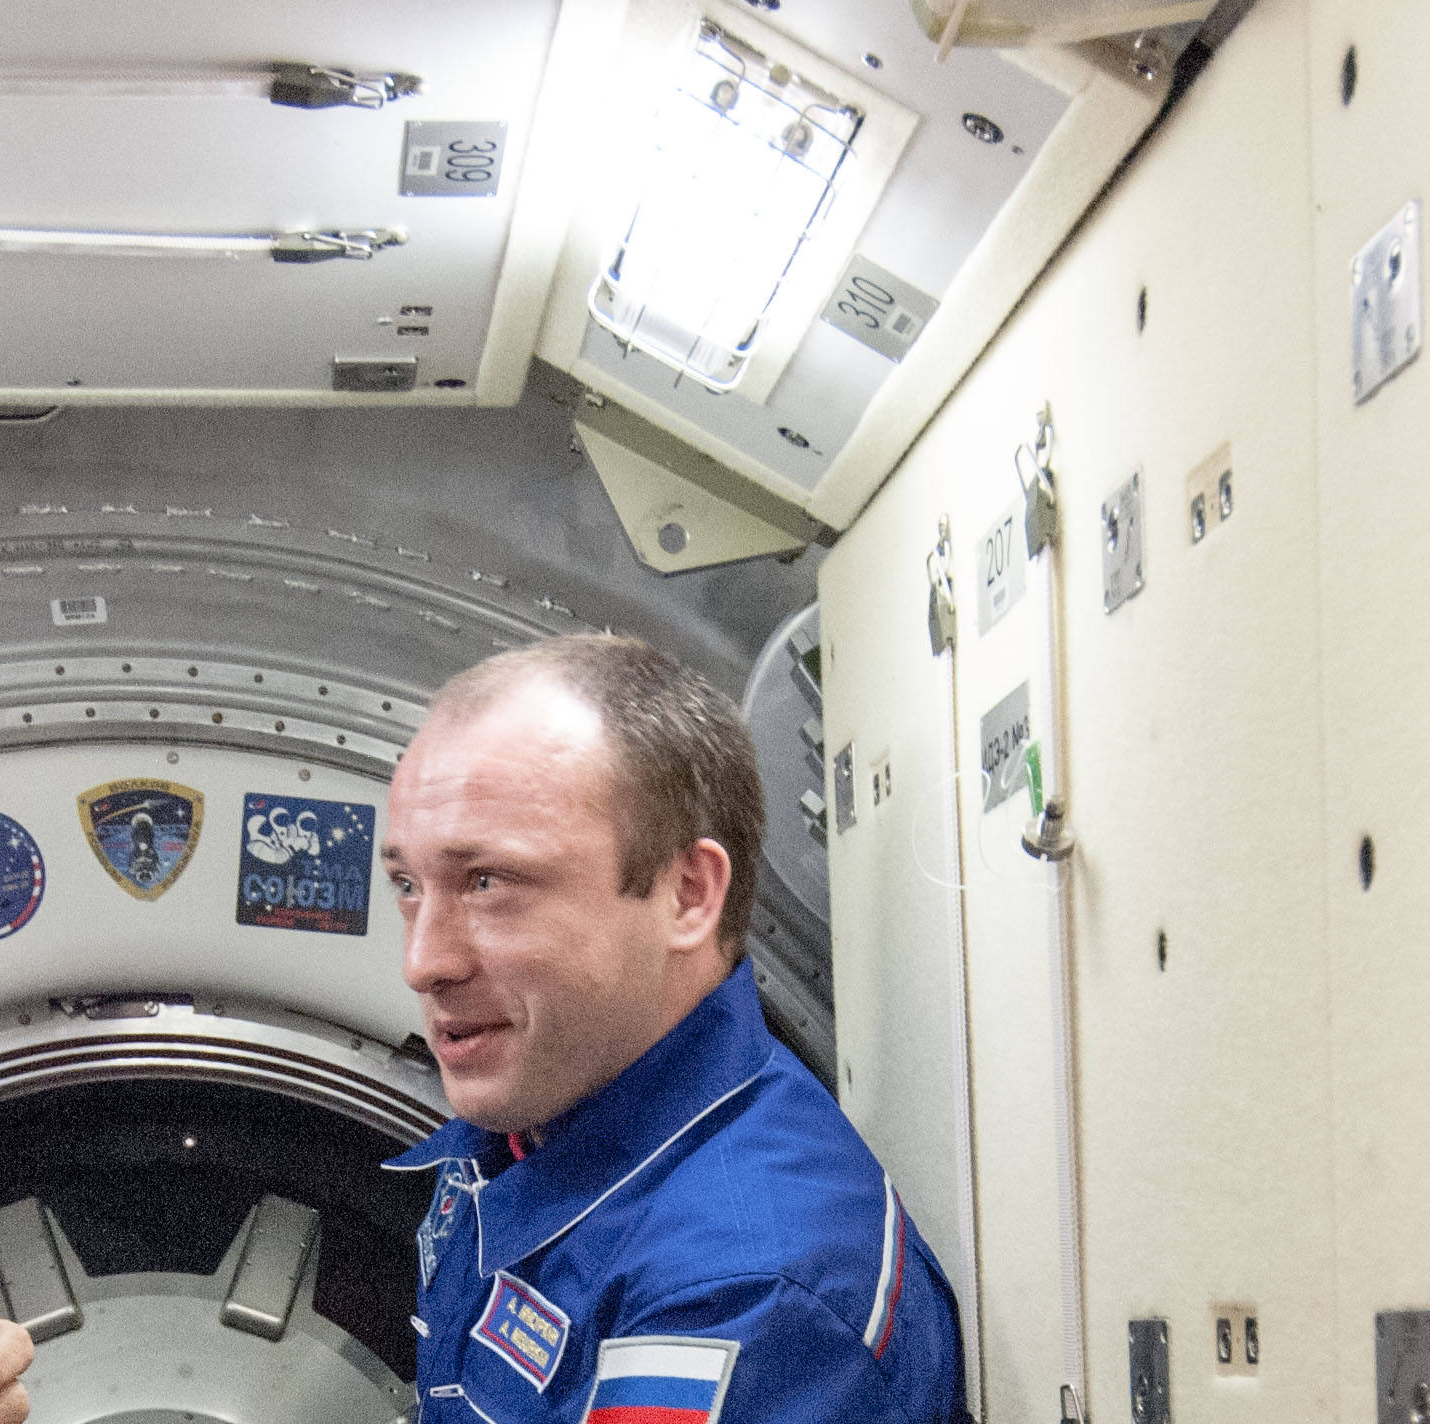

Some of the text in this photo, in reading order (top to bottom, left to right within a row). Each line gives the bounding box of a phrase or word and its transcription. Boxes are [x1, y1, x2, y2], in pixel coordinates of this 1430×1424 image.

[444, 140, 497, 183] 309
[837, 276, 896, 329] 310
[986, 515, 1013, 588] 207
